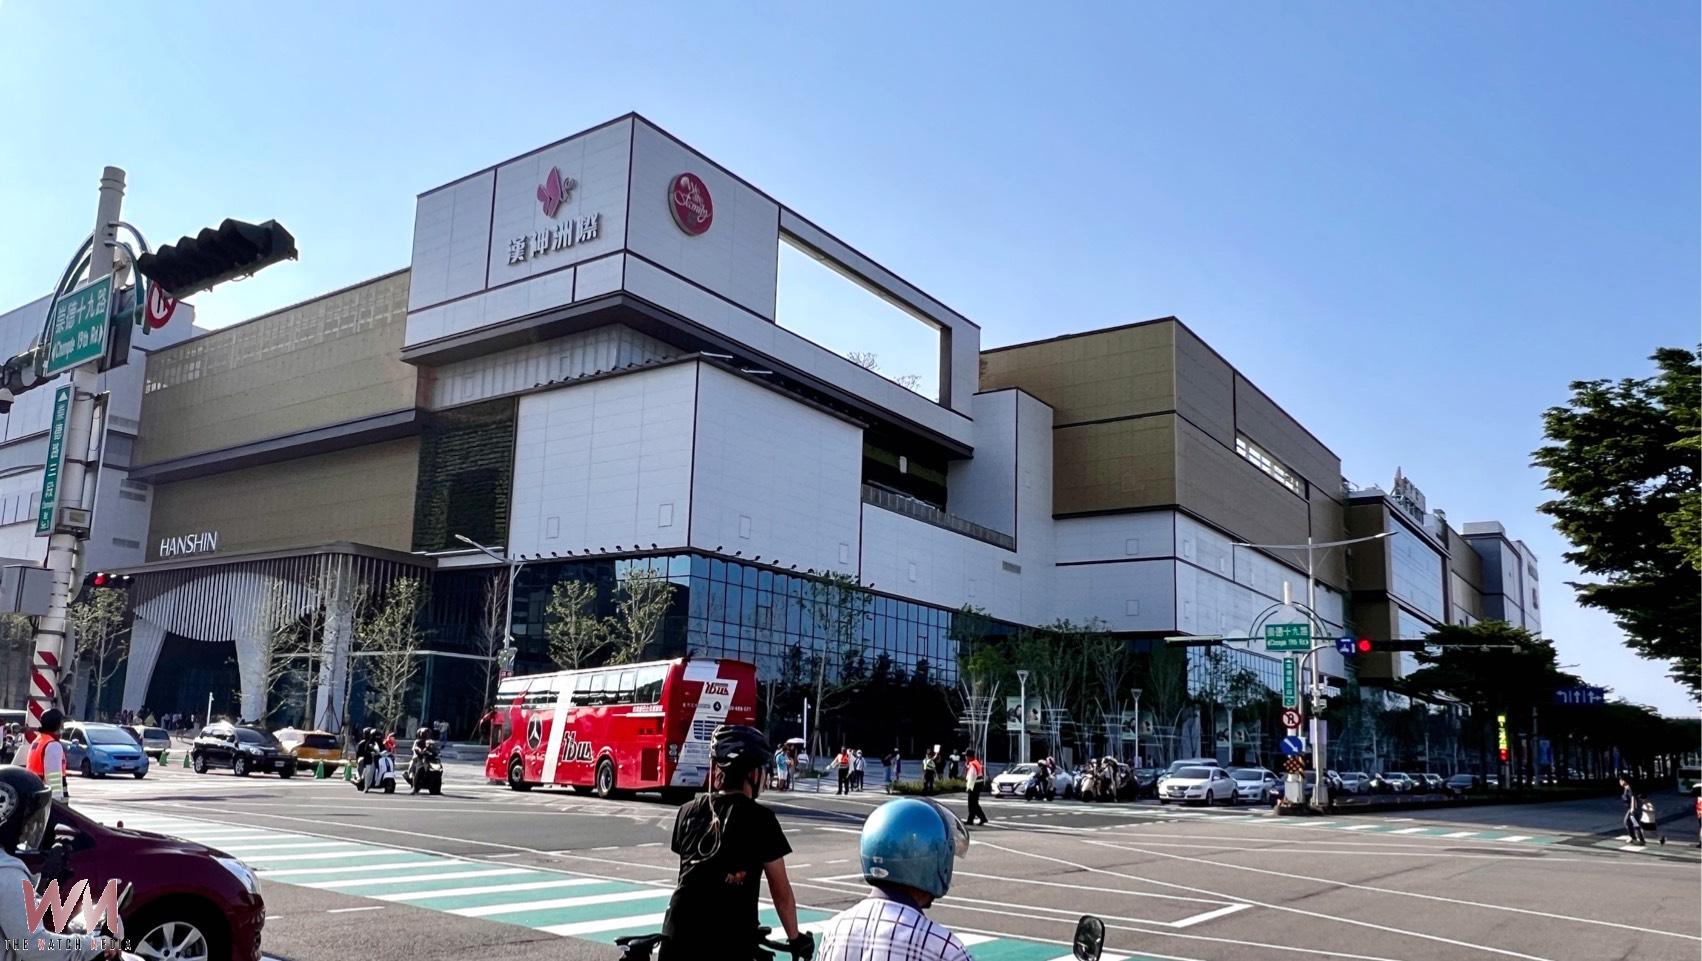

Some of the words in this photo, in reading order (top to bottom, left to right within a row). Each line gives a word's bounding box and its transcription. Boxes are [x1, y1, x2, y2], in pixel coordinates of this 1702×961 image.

[508, 213, 600, 263] 漢神洲際
[56, 288, 107, 334] 崇德十九路
[160, 531, 217, 557] HANSHIN
